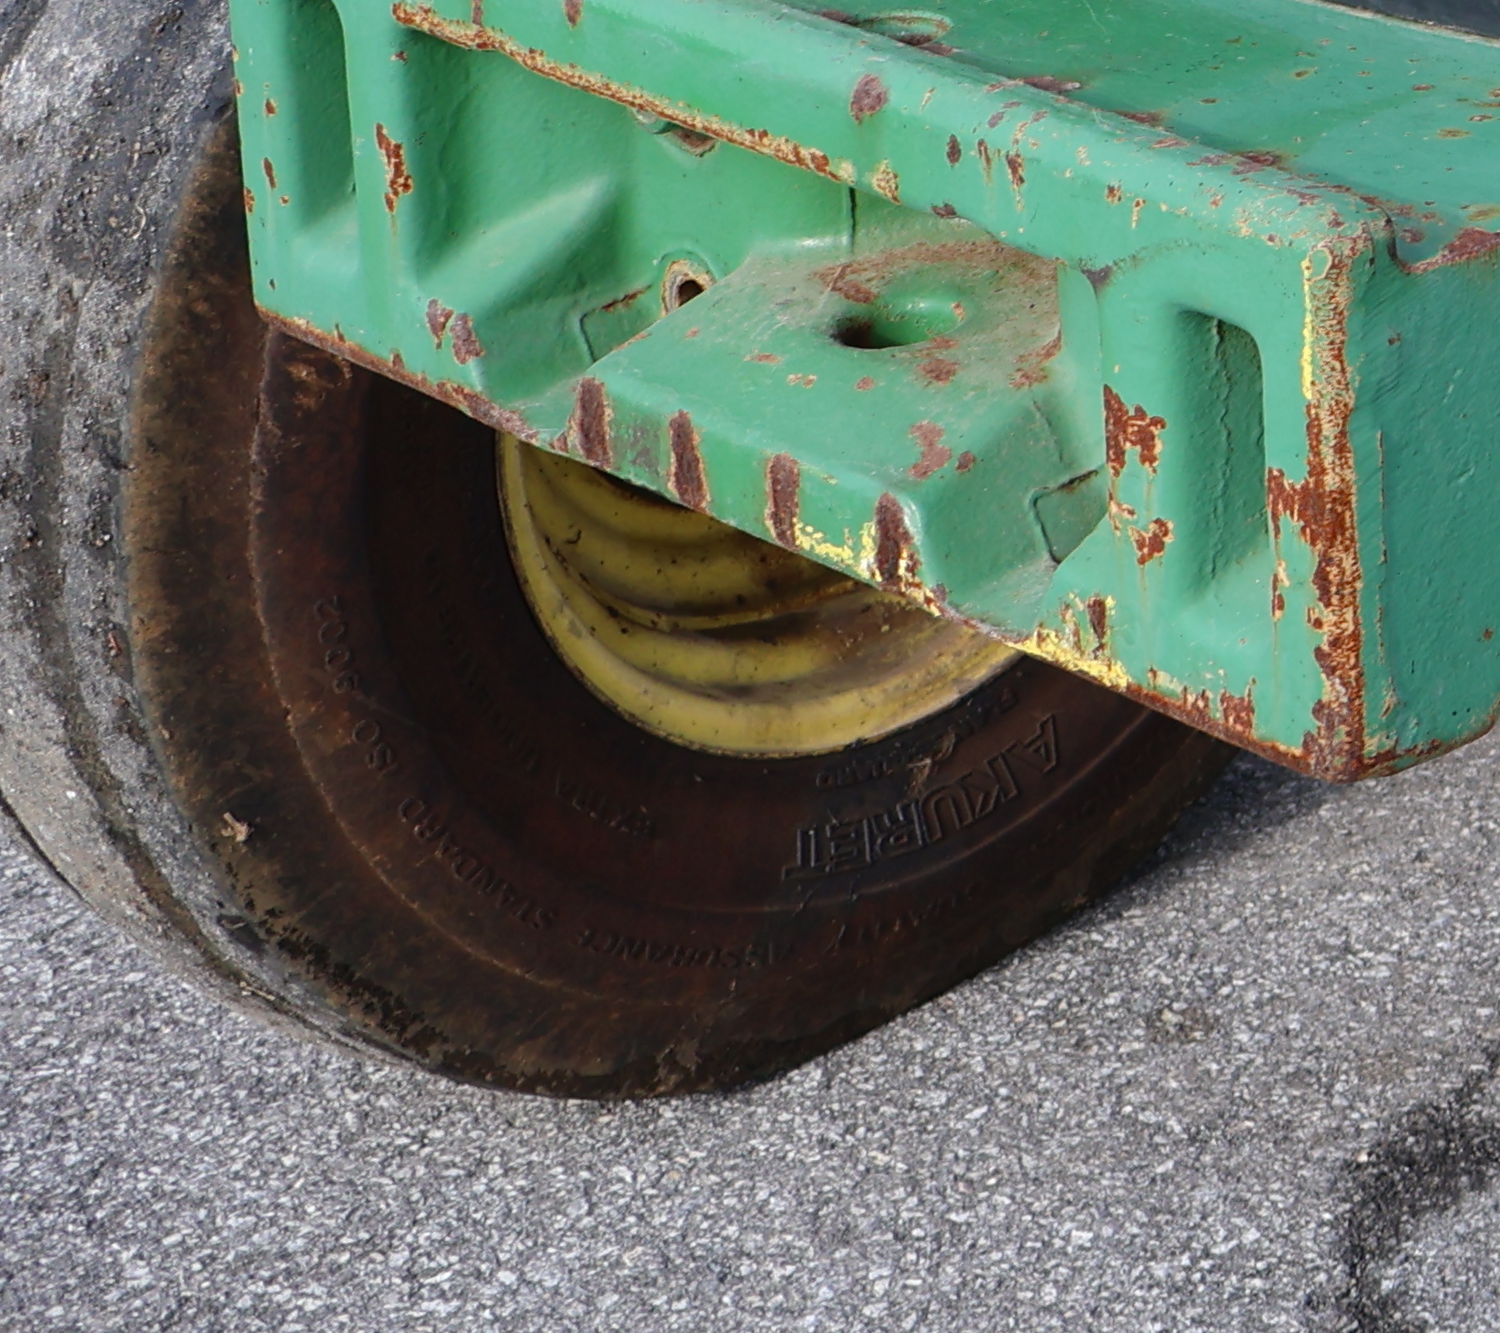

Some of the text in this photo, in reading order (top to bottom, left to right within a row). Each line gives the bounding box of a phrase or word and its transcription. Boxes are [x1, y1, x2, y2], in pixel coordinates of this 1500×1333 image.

[306, 592, 367, 700] 9002
[344, 714, 404, 783] ISO
[780, 713, 1063, 882] AKURET
[394, 790, 559, 935] STANDARD
[566, 920, 794, 969] ASSURANCE
